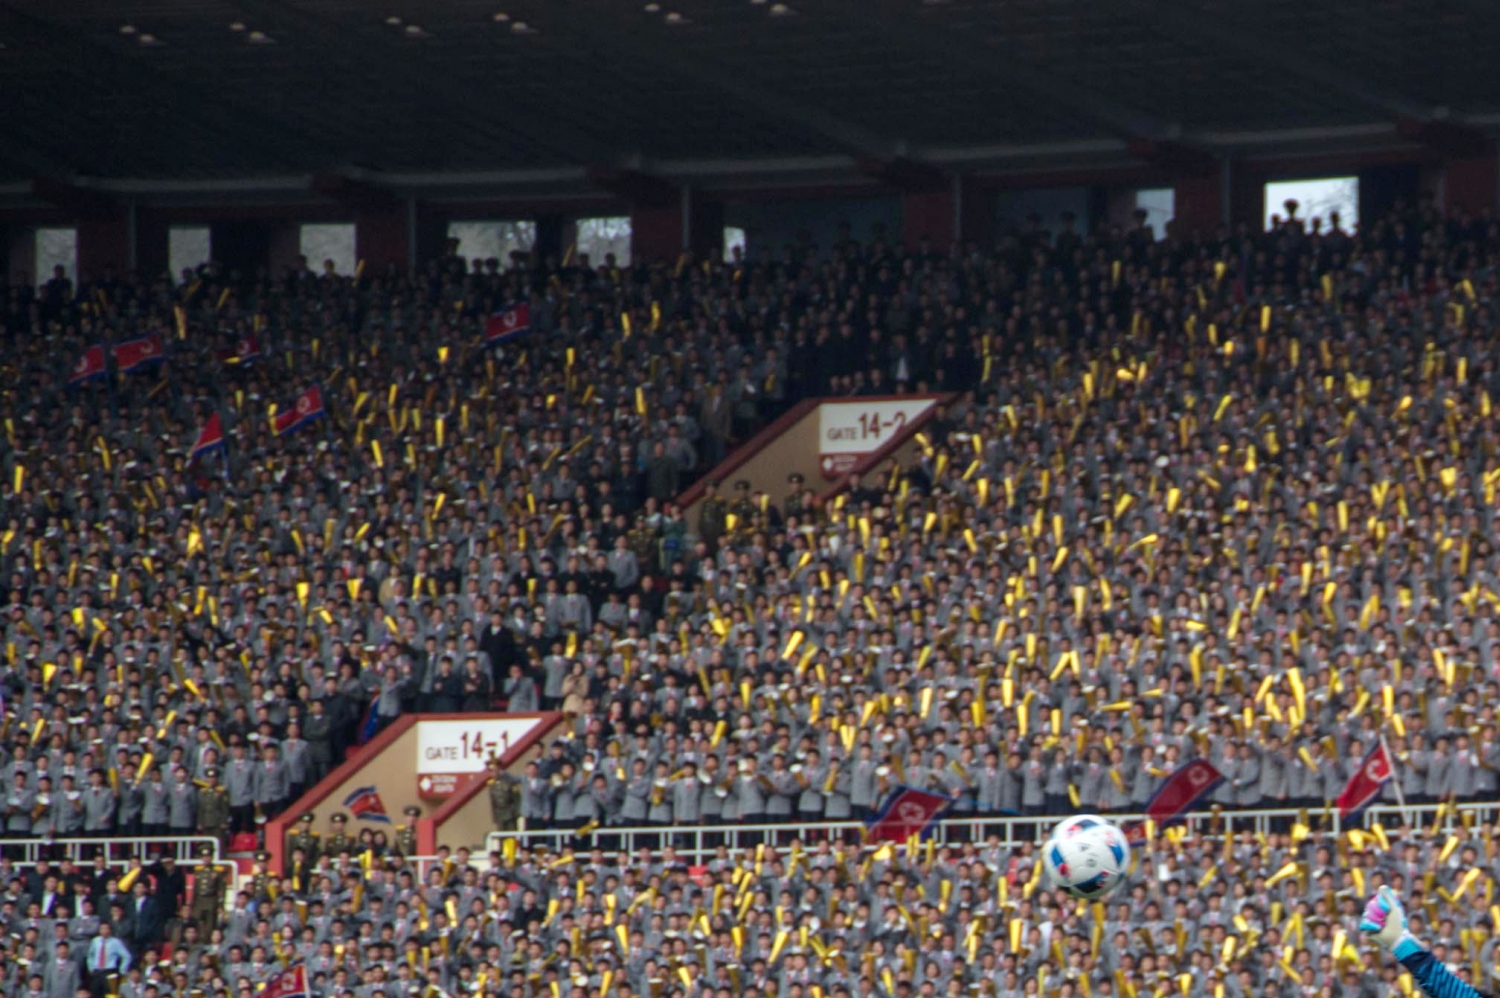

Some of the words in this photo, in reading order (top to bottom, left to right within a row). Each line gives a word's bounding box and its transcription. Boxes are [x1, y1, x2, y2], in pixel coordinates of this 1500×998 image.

[827, 427, 857, 441] GATE
[425, 746, 458, 761] GATE
[460, 730, 509, 759] 14-1
